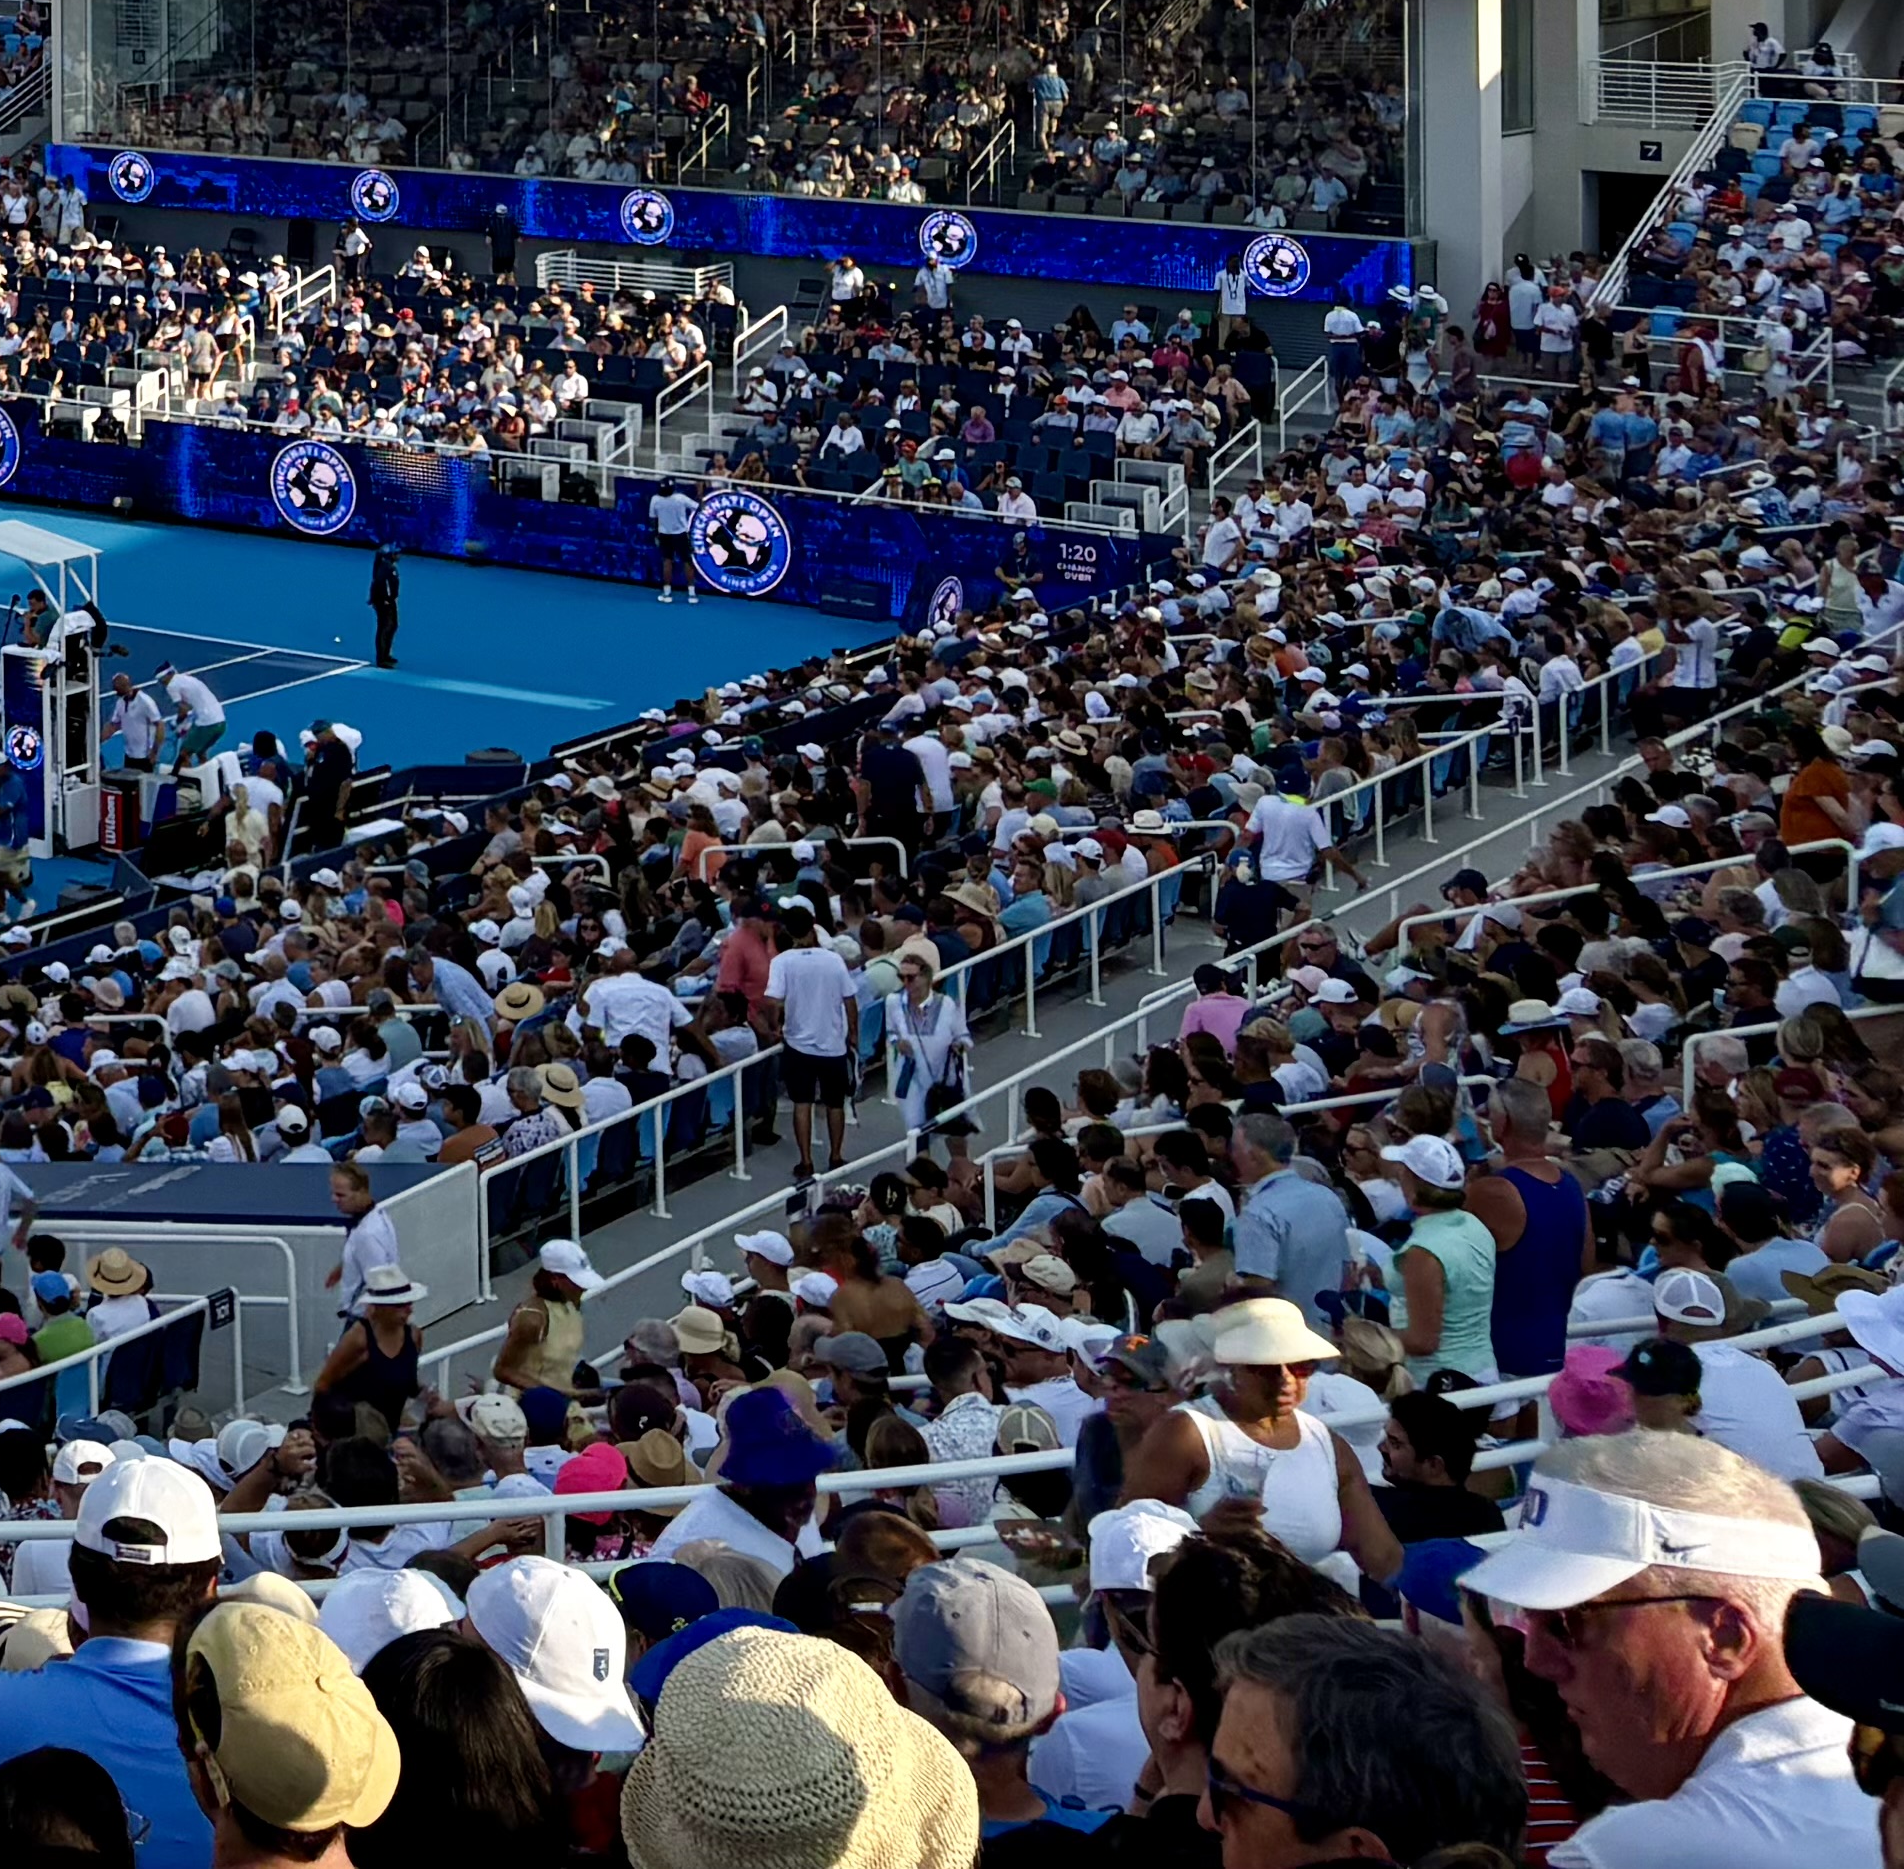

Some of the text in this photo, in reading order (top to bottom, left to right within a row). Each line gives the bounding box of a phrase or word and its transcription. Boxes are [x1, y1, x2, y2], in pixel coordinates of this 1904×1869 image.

[1643, 145, 1658, 157] 7
[1059, 543, 1097, 562] 1:20
[105, 795, 116, 845] Wilson
